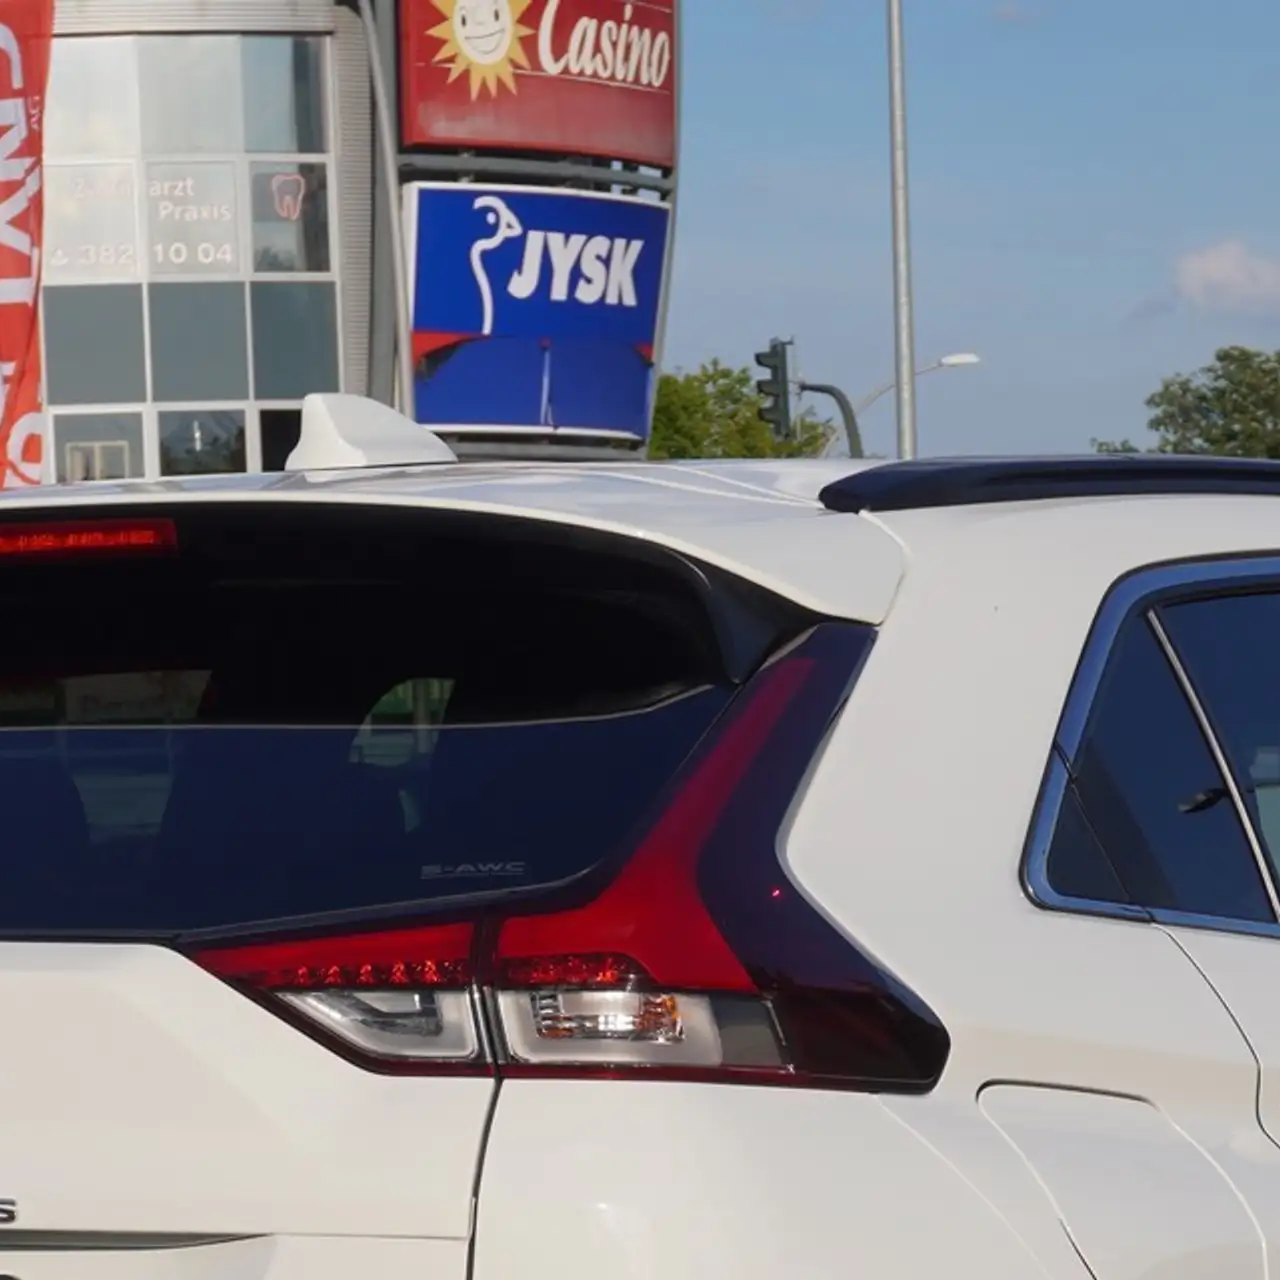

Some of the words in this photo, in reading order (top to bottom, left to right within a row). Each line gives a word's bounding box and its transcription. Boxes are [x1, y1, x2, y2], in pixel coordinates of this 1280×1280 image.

[538, 0, 671, 88] Casino
[157, 200, 233, 222] Praxis
[78, 243, 134, 264] 382
[153, 242, 188, 264] 10
[196, 242, 233, 264] 04
[507, 230, 645, 307] JYSK
